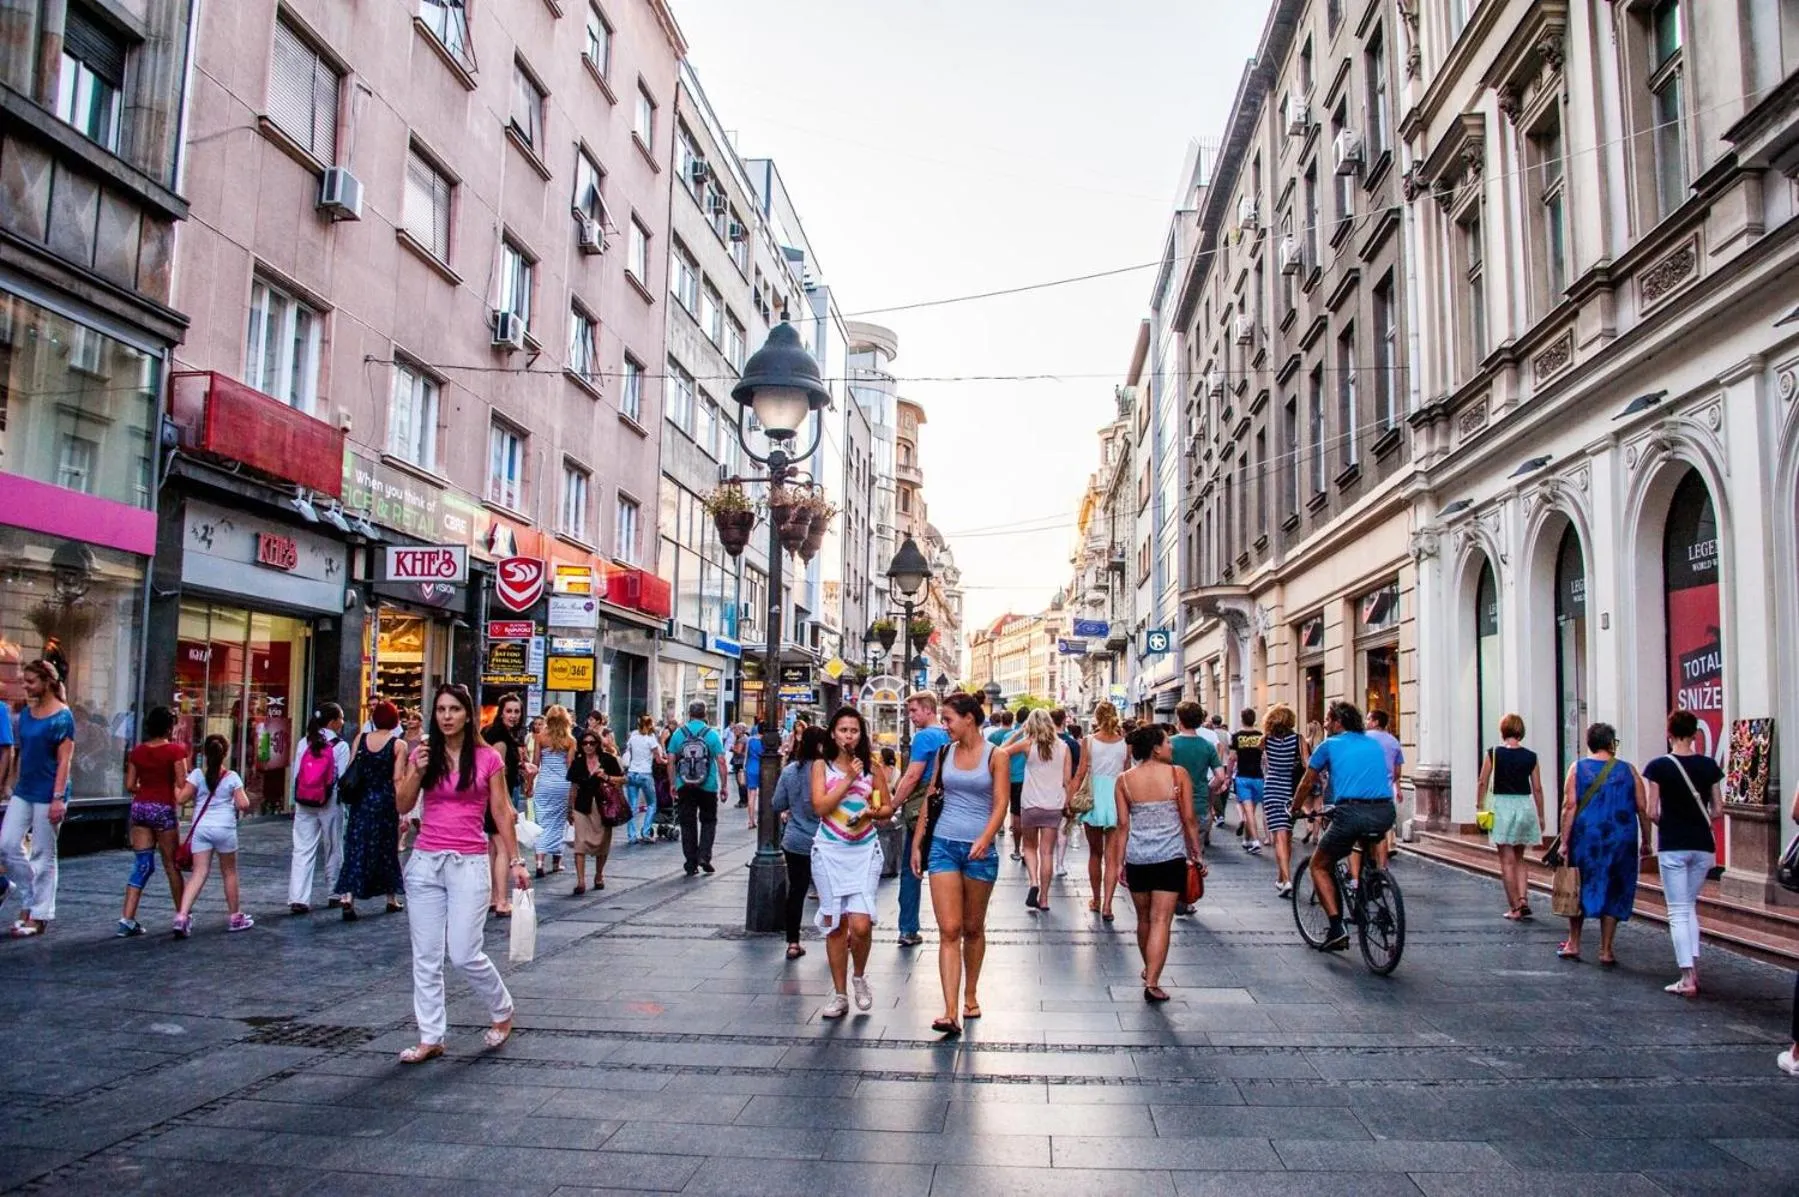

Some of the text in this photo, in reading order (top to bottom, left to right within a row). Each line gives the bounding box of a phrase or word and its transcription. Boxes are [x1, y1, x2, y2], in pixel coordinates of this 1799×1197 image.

[355, 469, 436, 512] When you think of
[393, 503, 437, 536] RETAIL
[1684, 651, 1722, 679] TOTAL
[1678, 681, 1722, 711] SNIŽE
